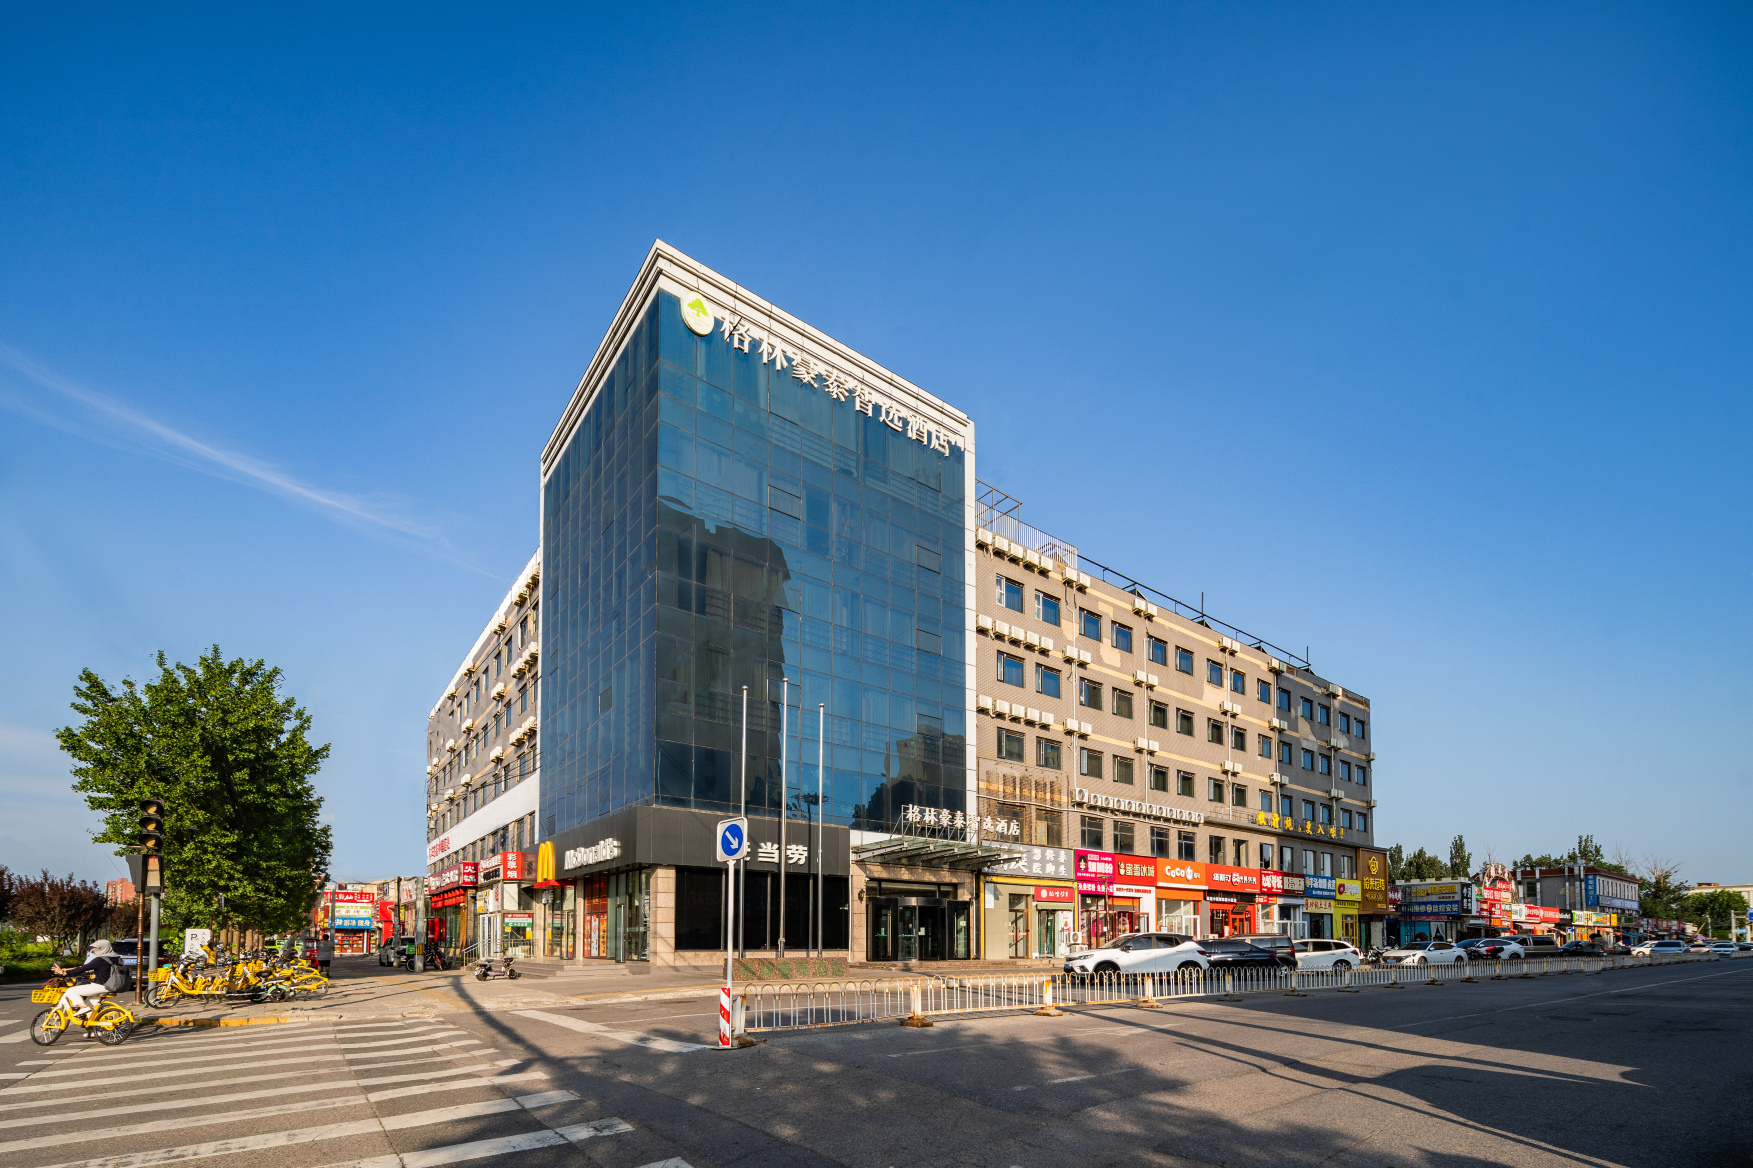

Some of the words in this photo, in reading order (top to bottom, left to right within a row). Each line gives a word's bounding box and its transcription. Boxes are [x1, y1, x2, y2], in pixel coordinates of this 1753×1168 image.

[719, 315, 951, 457] 格林豪泰智选酒店
[906, 803, 1020, 836] 格林豪泰智选酒店
[745, 842, 808, 865] 当劳
[1125, 863, 1155, 877] 蜜雪冰城
